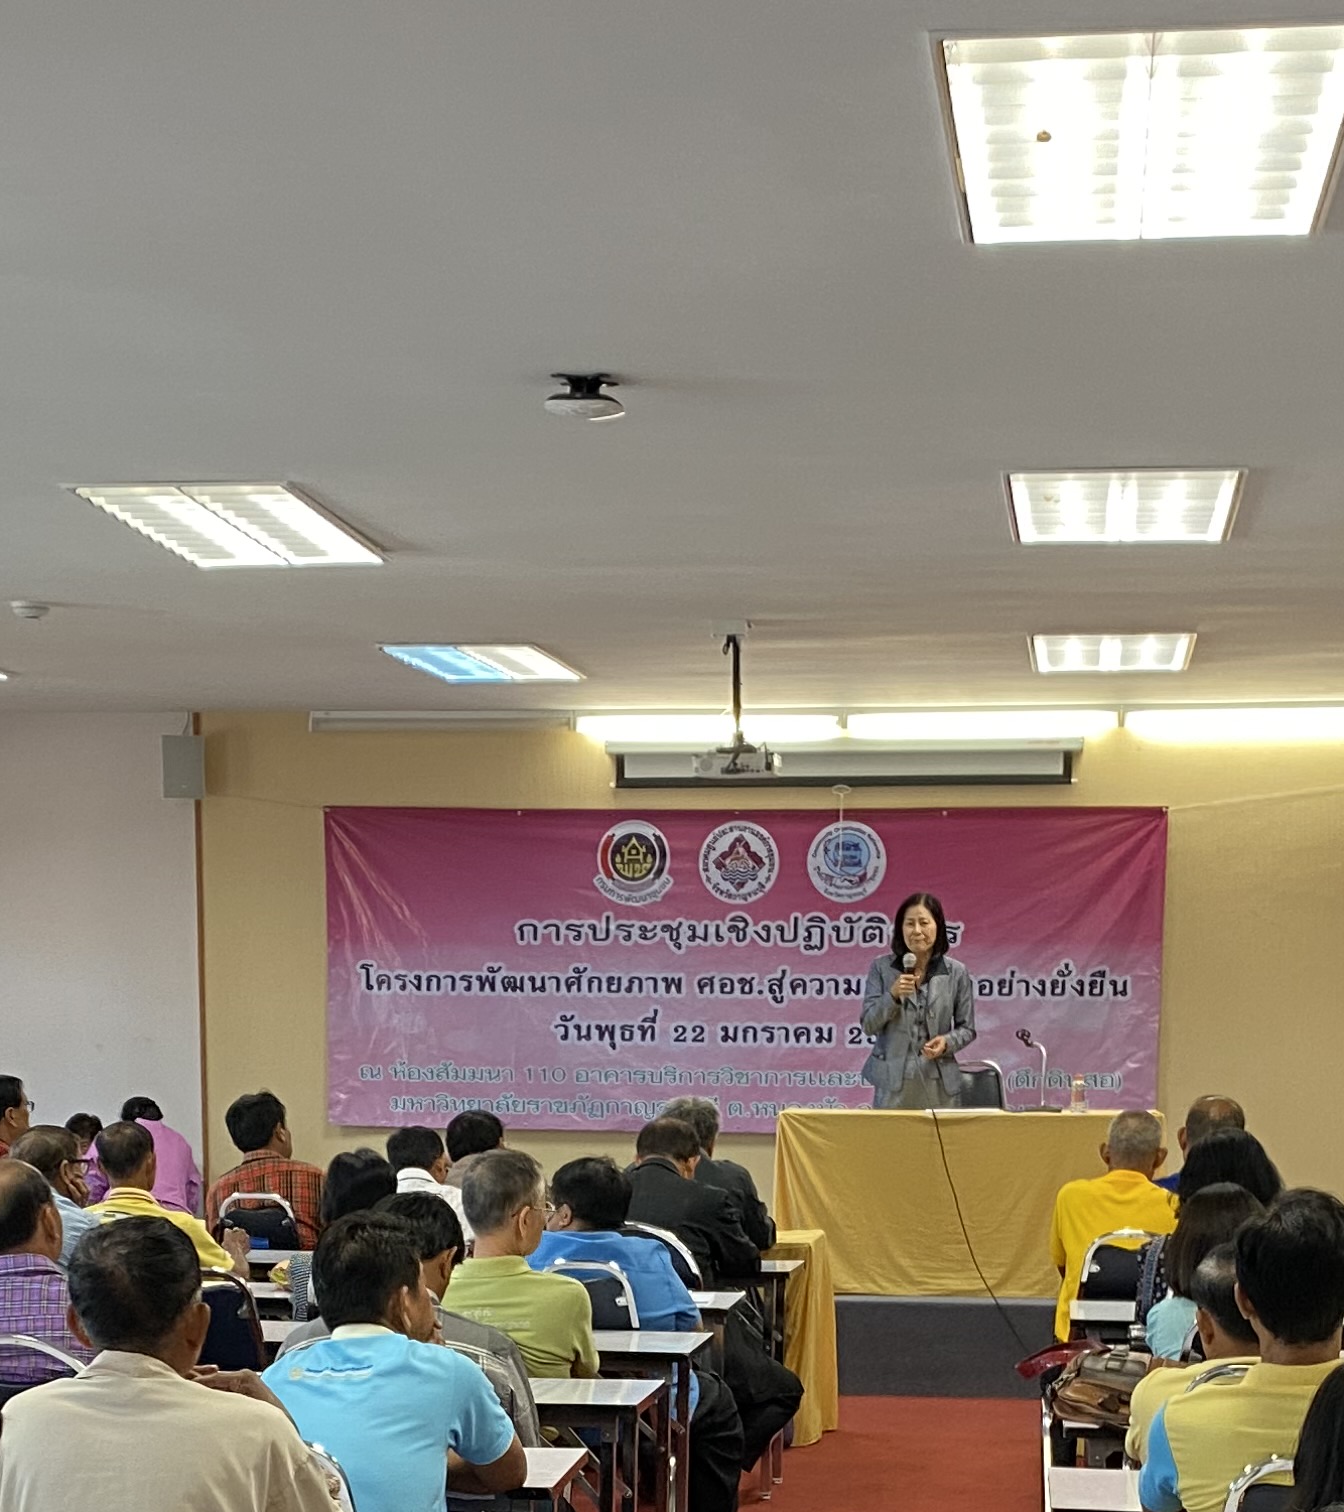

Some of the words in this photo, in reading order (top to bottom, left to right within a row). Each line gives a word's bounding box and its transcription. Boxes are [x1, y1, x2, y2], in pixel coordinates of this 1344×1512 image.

[516, 915, 961, 951] การประชุมเชิงปฏิบัติร
[359, 964, 683, 994] โครงการพัฒนาศักยภาพ
[554, 1009, 659, 1050] วันพุธที่
[673, 1024, 706, 1044] 22
[720, 1024, 834, 1044] มกราคม
[359, 1065, 382, 1081] ณ
[392, 1061, 515, 1083] ห้องสัมมนา
[526, 1067, 567, 1083] 110
